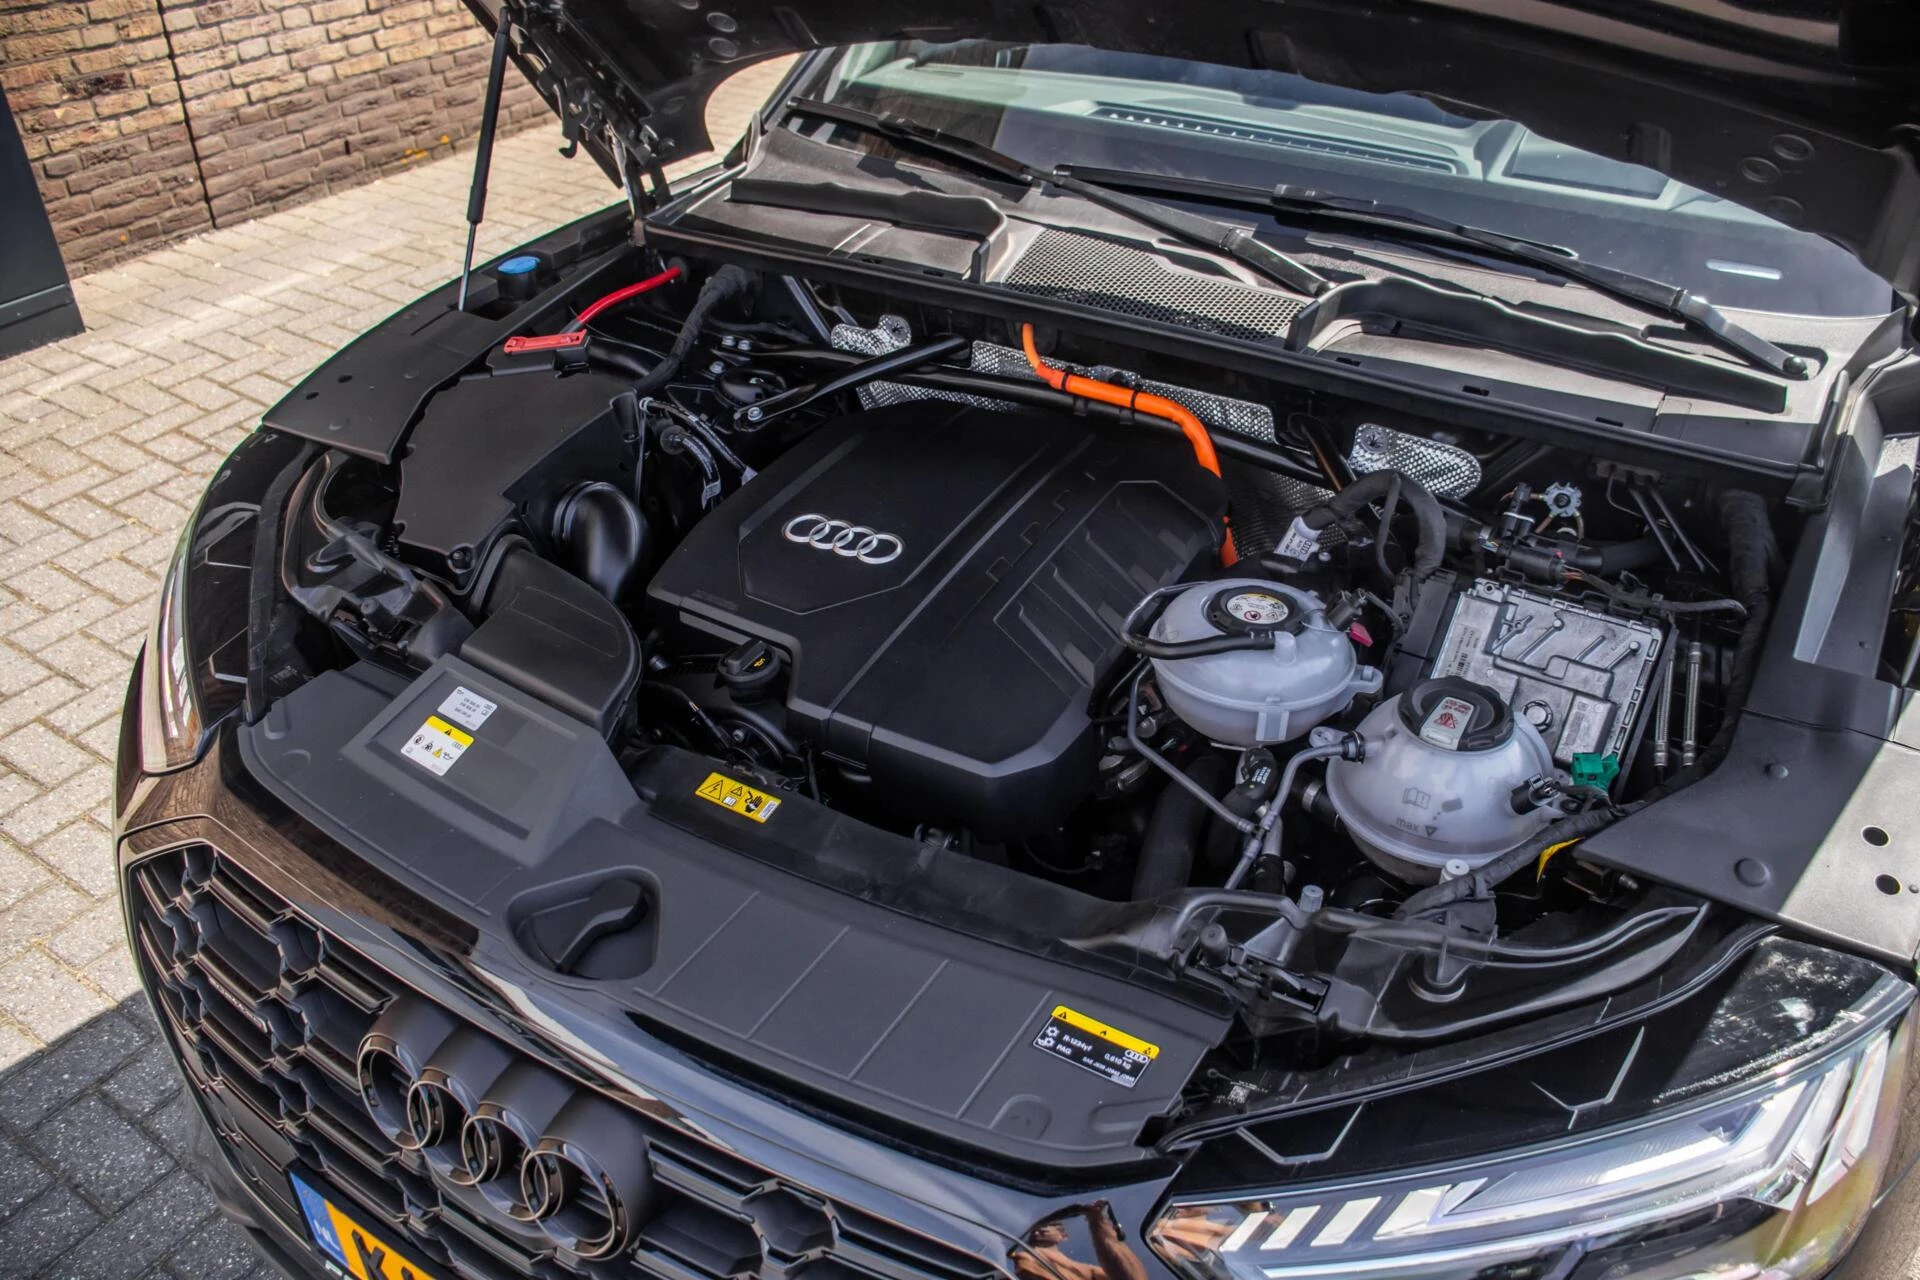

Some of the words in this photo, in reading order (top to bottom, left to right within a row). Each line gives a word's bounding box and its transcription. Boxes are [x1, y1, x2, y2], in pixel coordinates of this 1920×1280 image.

[1396, 817, 1419, 833] max
[1056, 1043, 1073, 1055] PAG
[1062, 1034, 1093, 1052] R-1234yf
